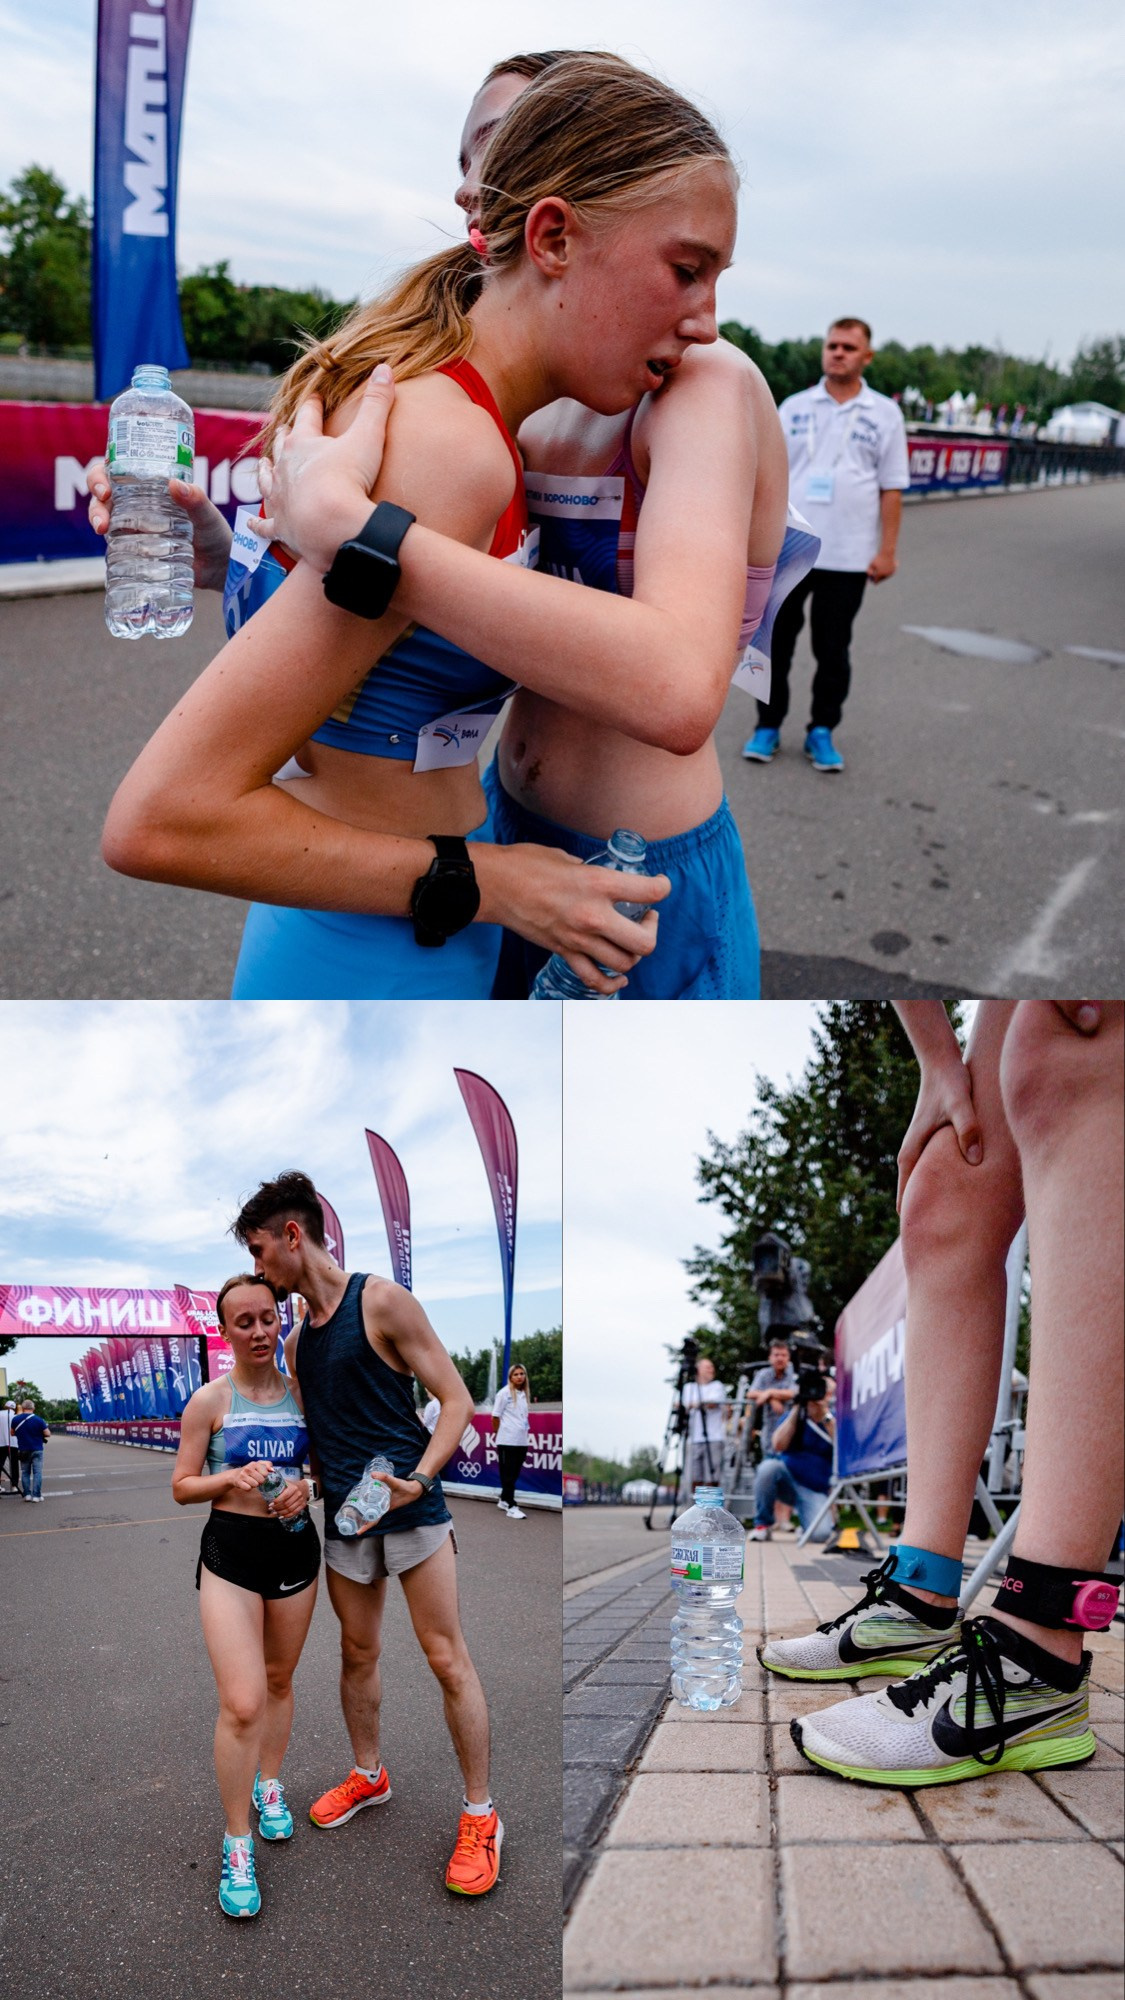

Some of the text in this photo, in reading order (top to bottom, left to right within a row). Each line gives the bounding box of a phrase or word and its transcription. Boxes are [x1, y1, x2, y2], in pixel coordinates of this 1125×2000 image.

[544, 492, 598, 506] ВОРОНОВО
[18, 1295, 172, 1327] ФИНИШ
[247, 1440, 295, 1458] SLIVAR
[485, 1433, 562, 1453] КАНД
[485, 1450, 562, 1471] РСИИ
